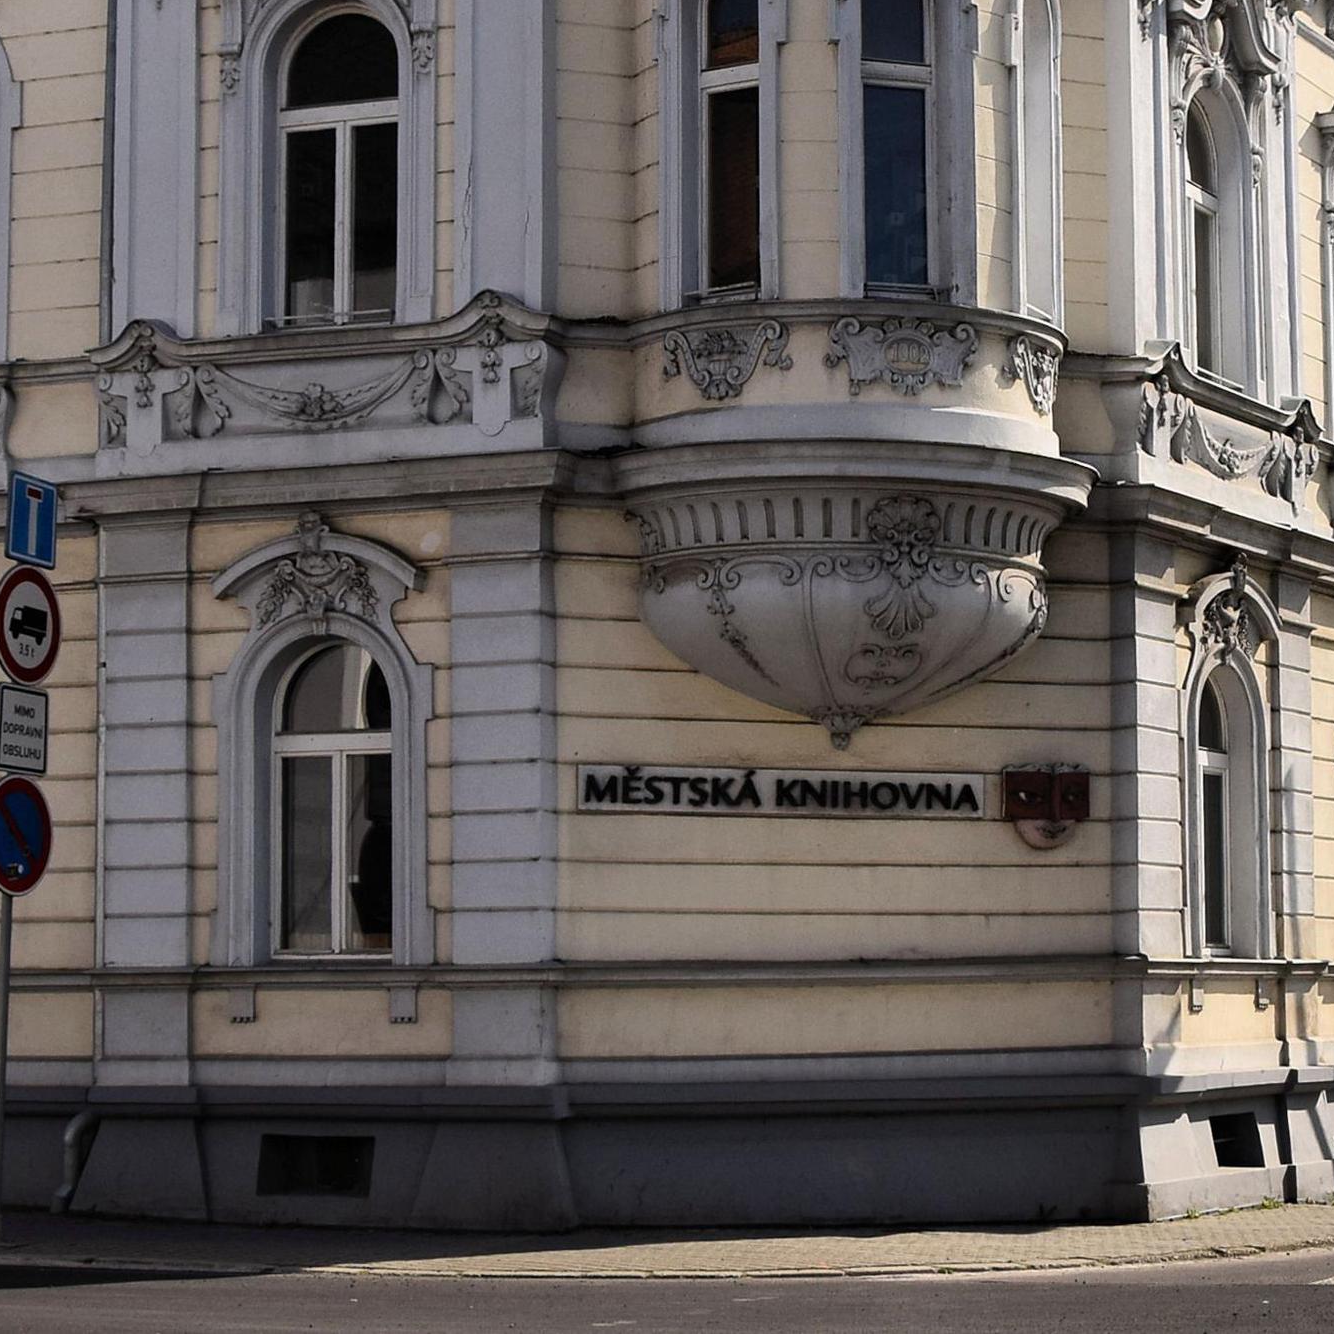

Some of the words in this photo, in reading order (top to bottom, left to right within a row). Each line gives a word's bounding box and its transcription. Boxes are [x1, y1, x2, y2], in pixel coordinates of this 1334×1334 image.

[14, 704, 35, 719] MIMO
[3, 744, 42, 760] OBSLUHU
[584, 766, 762, 808] MĚSTSKÁ
[775, 778, 979, 813] KNIHOVNA
